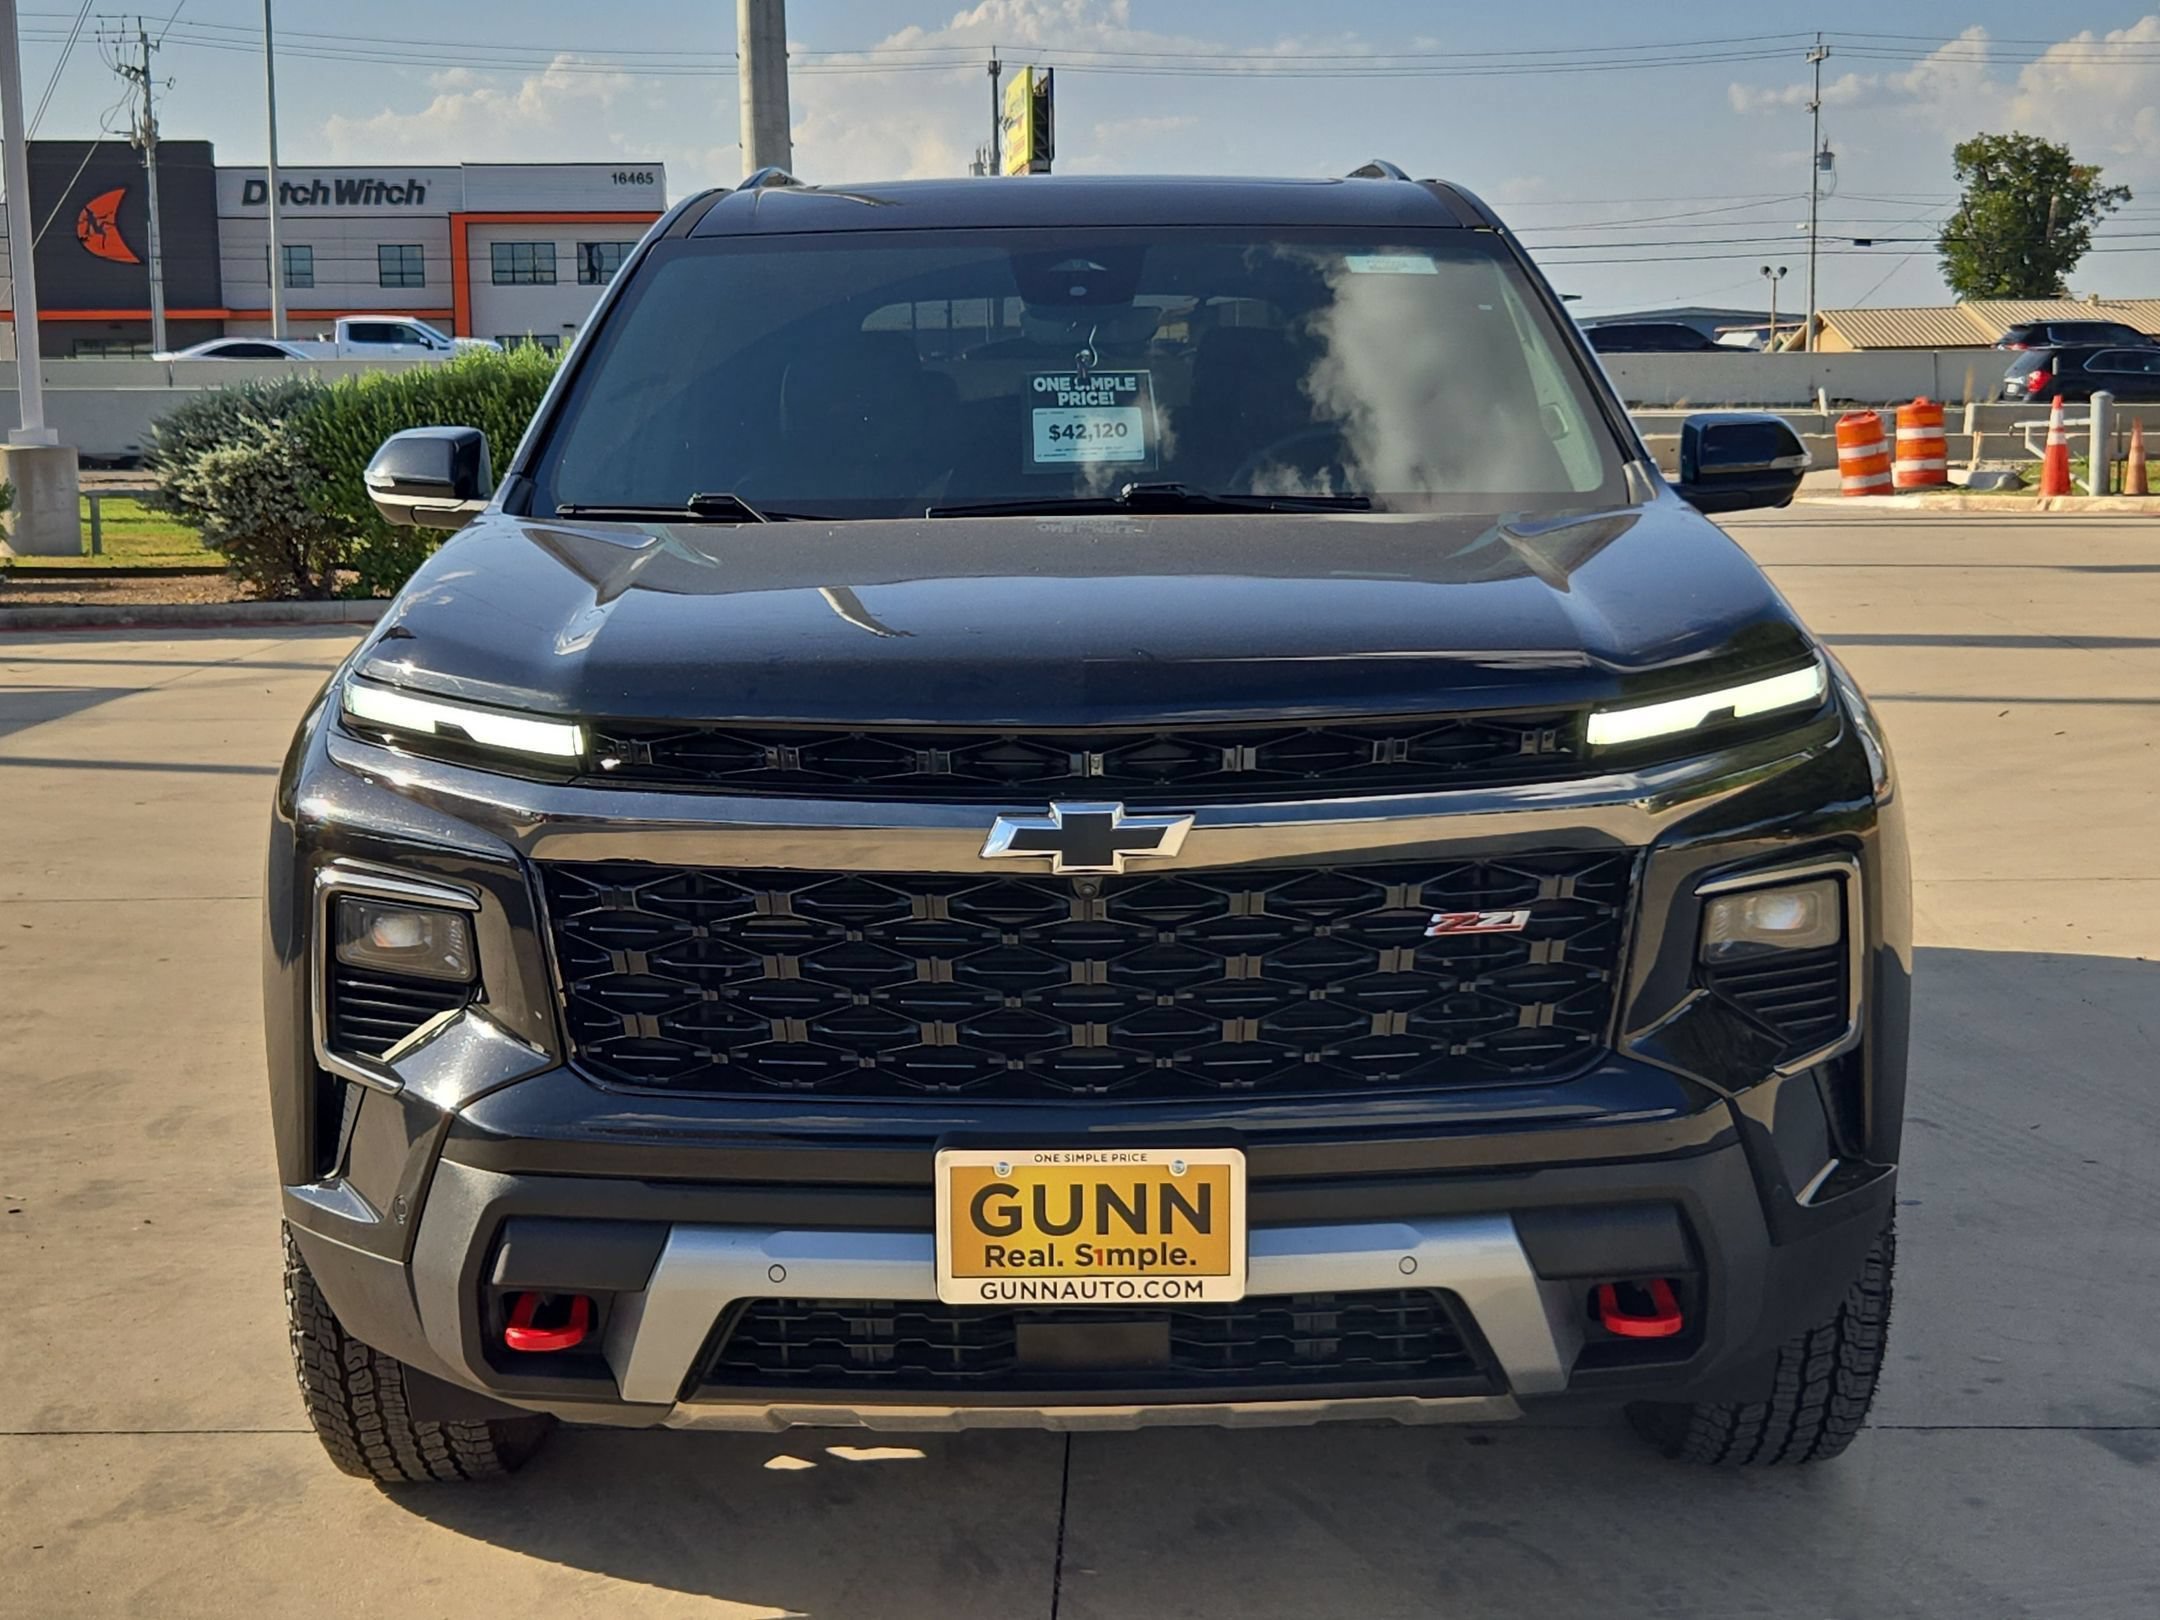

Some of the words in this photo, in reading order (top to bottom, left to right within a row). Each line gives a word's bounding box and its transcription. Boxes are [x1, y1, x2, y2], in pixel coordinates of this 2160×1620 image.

[611, 172, 654, 185] 16465
[242, 179, 330, 206] Dtch
[334, 178, 426, 205] Witch
[1033, 377, 1071, 392] ONE
[1074, 377, 1137, 391] SMPLE
[1057, 391, 1115, 406] PRICE!
[1048, 422, 1128, 442] $42,120
[1424, 910, 1531, 936] Z71
[1034, 1153, 1061, 1163] ONE
[1064, 1153, 1108, 1163] SIMPLE
[1111, 1153, 1148, 1162] PRICE
[970, 1183, 1211, 1237] GUNN
[985, 1243, 1064, 1267] Real.
[980, 1281, 1203, 1299] GUNNAUTO.COM
